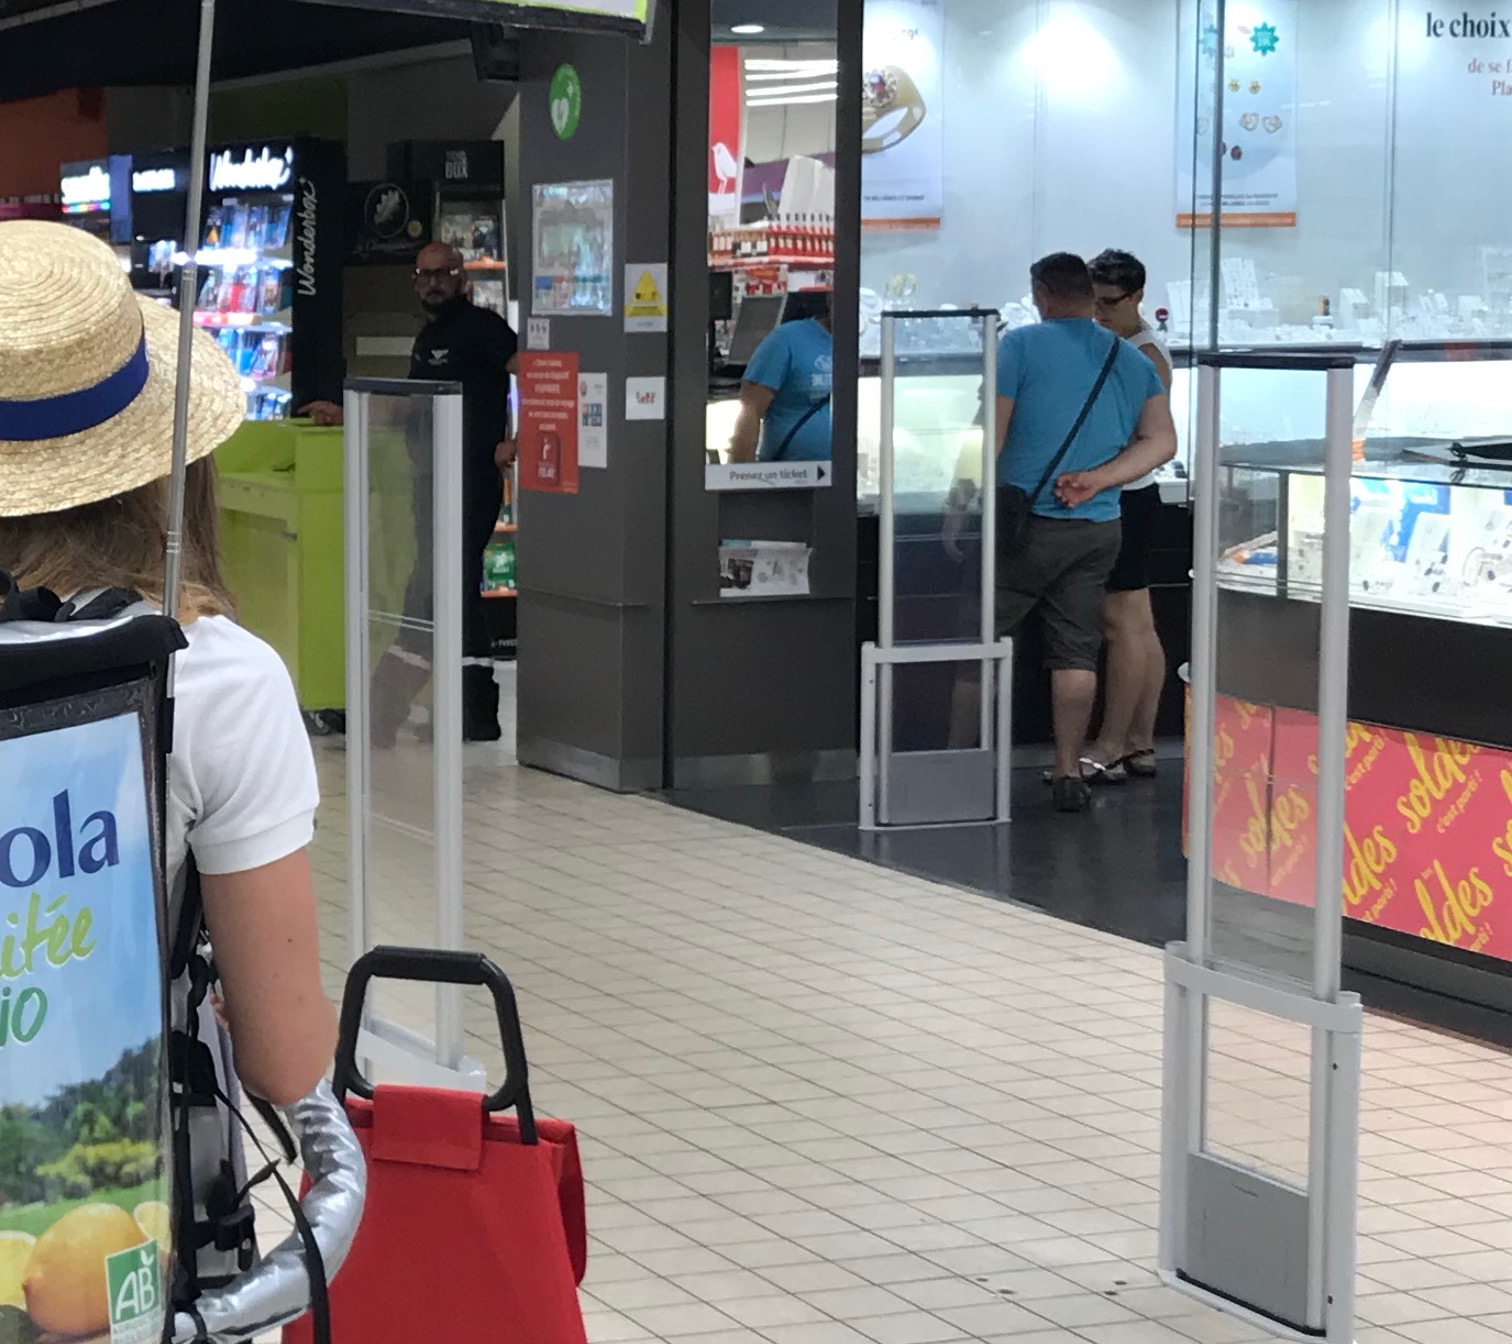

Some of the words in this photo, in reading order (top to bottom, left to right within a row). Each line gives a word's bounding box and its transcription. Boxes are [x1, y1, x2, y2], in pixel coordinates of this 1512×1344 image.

[1426, 11, 1445, 38] le
[1449, 11, 1511, 38] choix
[1467, 57, 1485, 74] de
[297, 179, 318, 297] Wonderbox
[729, 469, 763, 481] Prenez
[764, 471, 778, 480] un
[779, 467, 808, 480] ticket
[114, 1263, 156, 1321] AB
